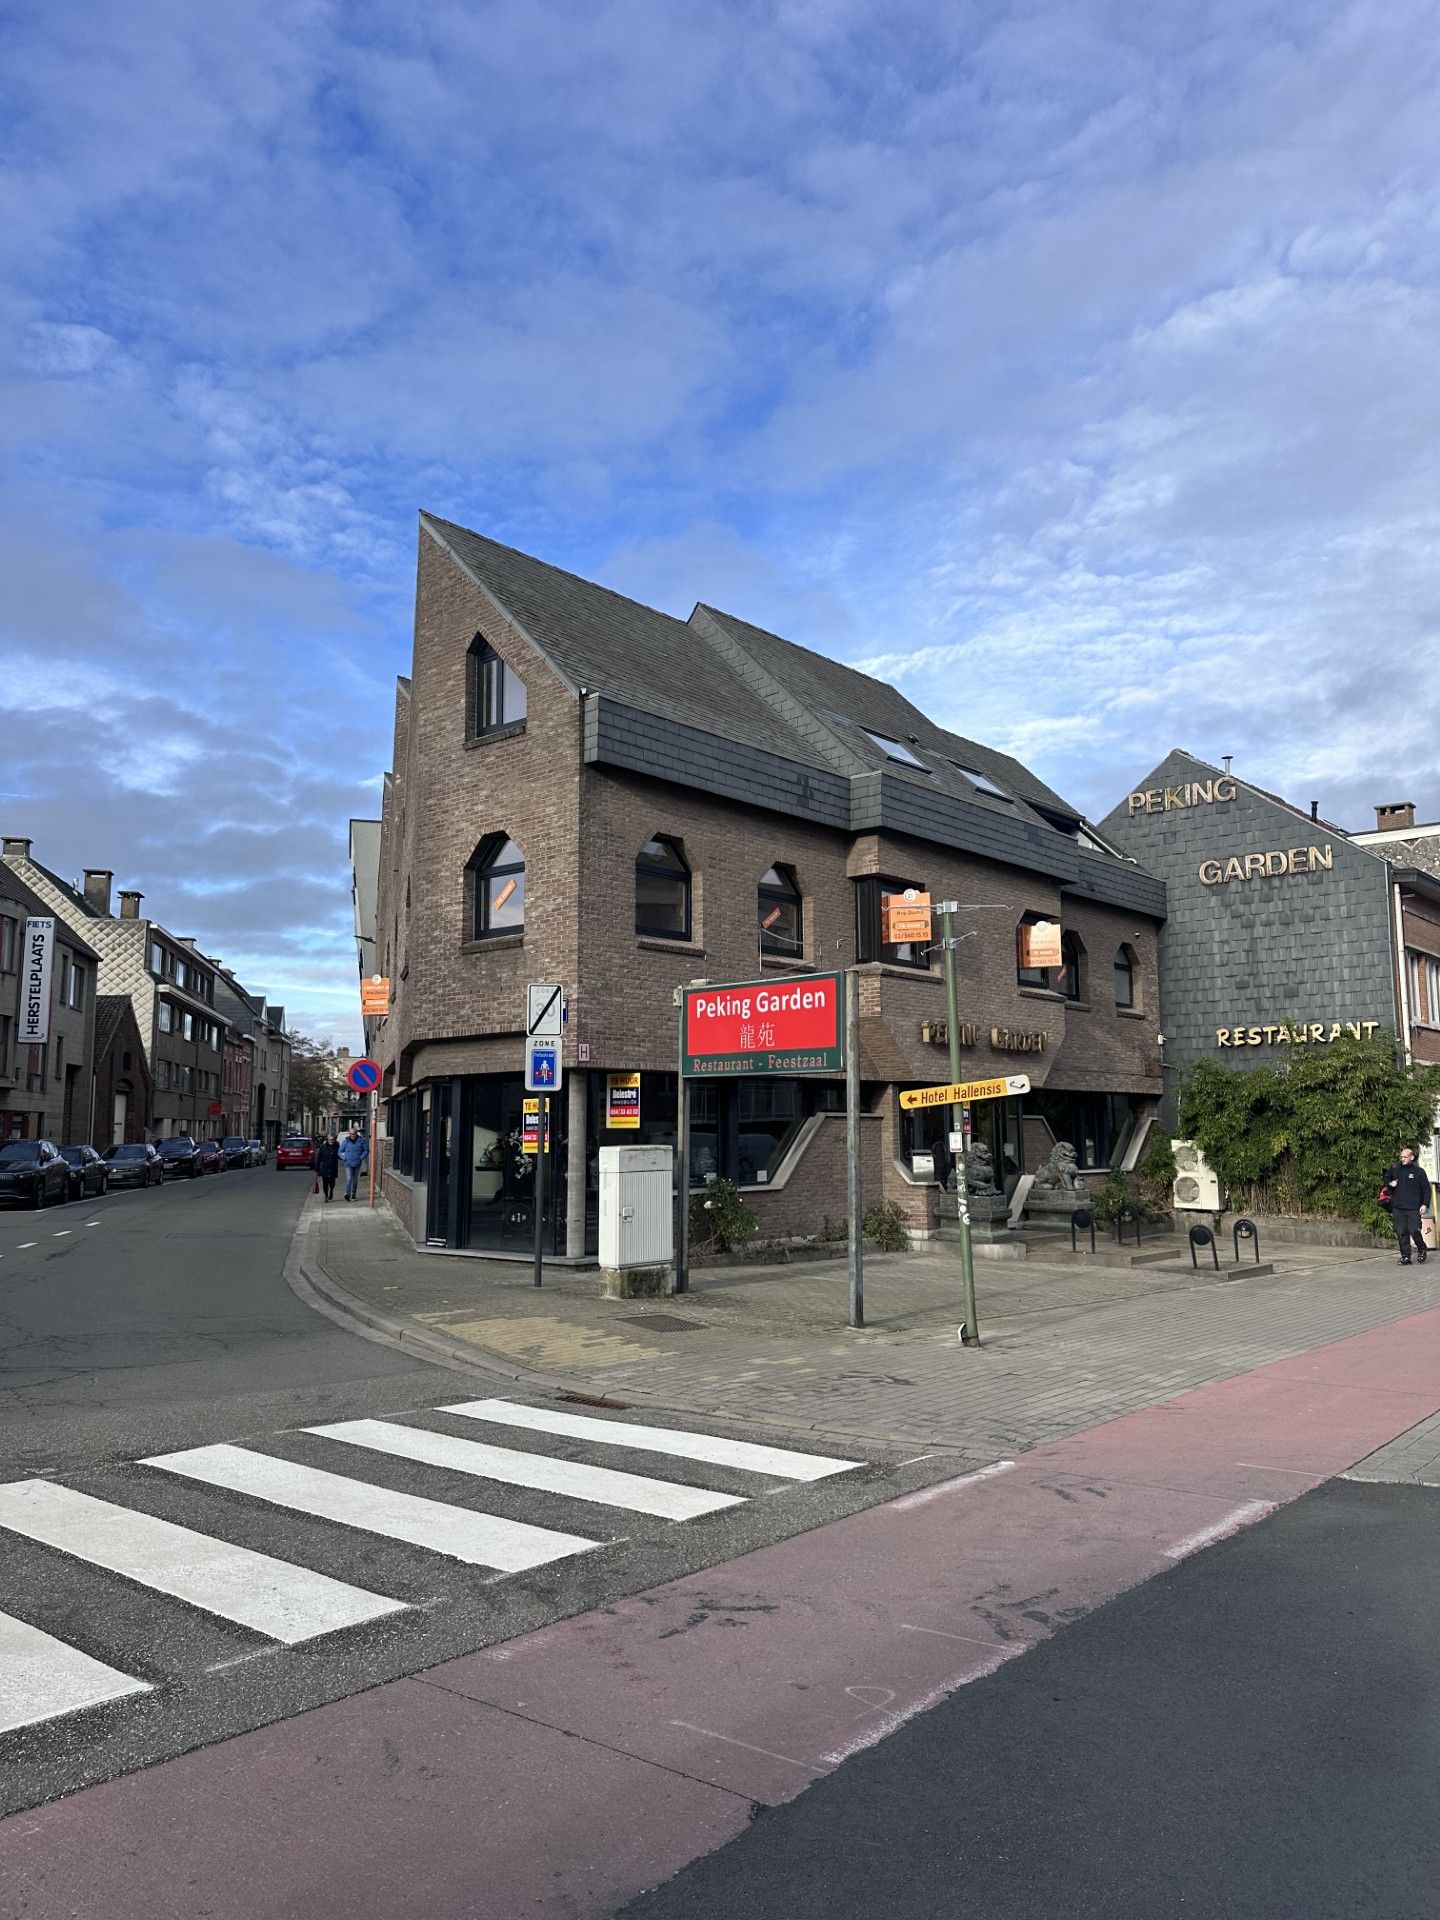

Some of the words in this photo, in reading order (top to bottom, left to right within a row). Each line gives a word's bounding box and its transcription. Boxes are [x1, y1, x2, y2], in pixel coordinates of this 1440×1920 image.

[1128, 777, 1237, 817] PEKING
[1198, 844, 1333, 886] GARDEN
[27, 920, 52, 928] FIETS
[26, 933, 45, 1035] HERSTELPLAATS
[696, 996, 751, 1019] Peking
[756, 987, 825, 1013] Garden
[739, 1022, 775, 1049] 龍苑
[1216, 1021, 1380, 1047] RESTAURANT
[580, 1045, 588, 1059] H
[693, 1057, 753, 1072] Restaurant
[768, 1052, 827, 1069] Feestzaal
[525, 1102, 531, 1111] TE
[921, 1089, 947, 1105] Hotel
[953, 1083, 1002, 1100] Hallensis
